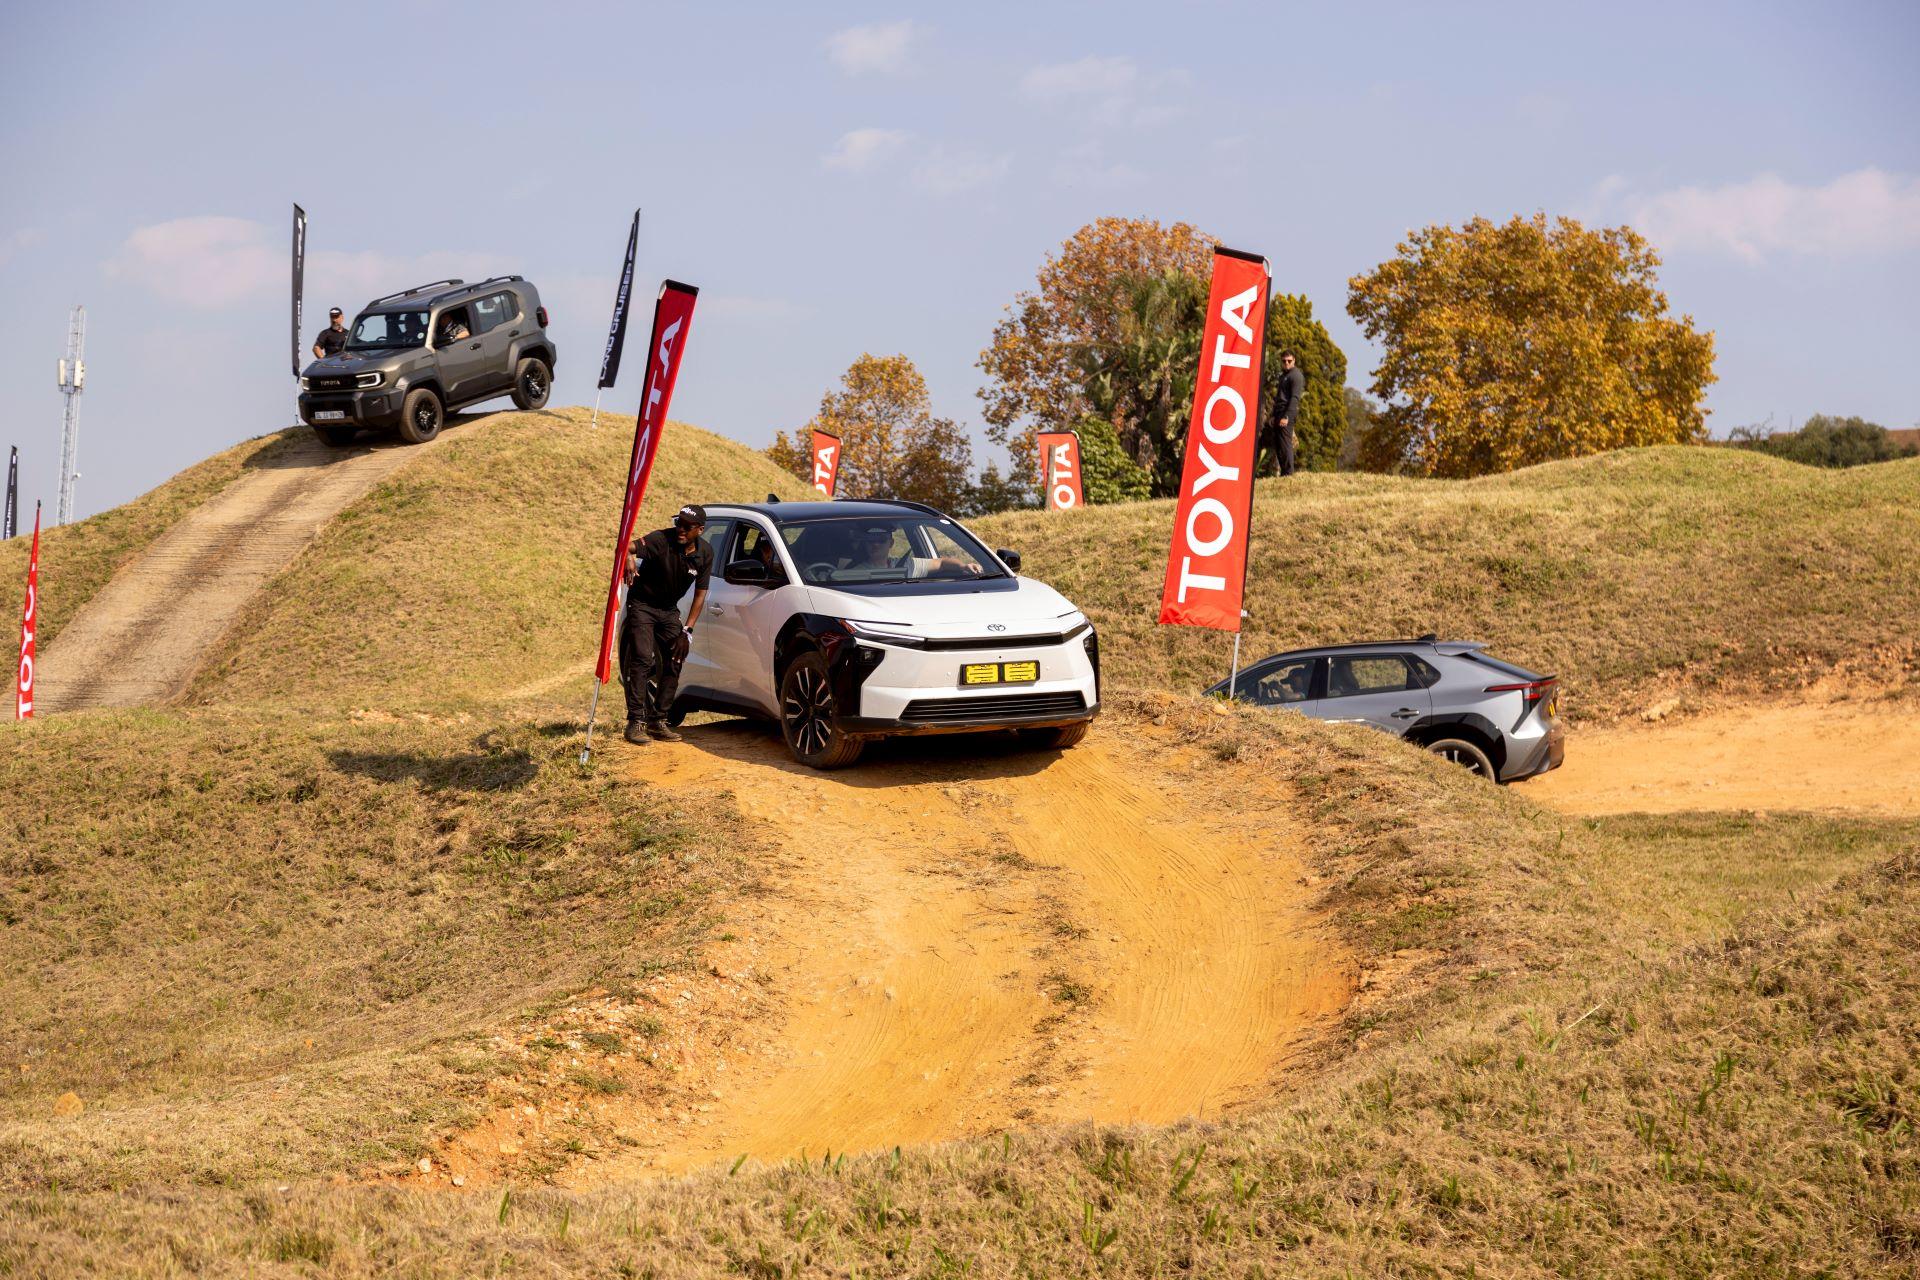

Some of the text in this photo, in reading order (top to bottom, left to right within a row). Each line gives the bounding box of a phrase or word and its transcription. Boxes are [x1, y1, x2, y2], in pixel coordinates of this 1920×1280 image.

[600, 262, 632, 381] LAND CRUISER
[1178, 285, 1258, 603] TOYOTA
